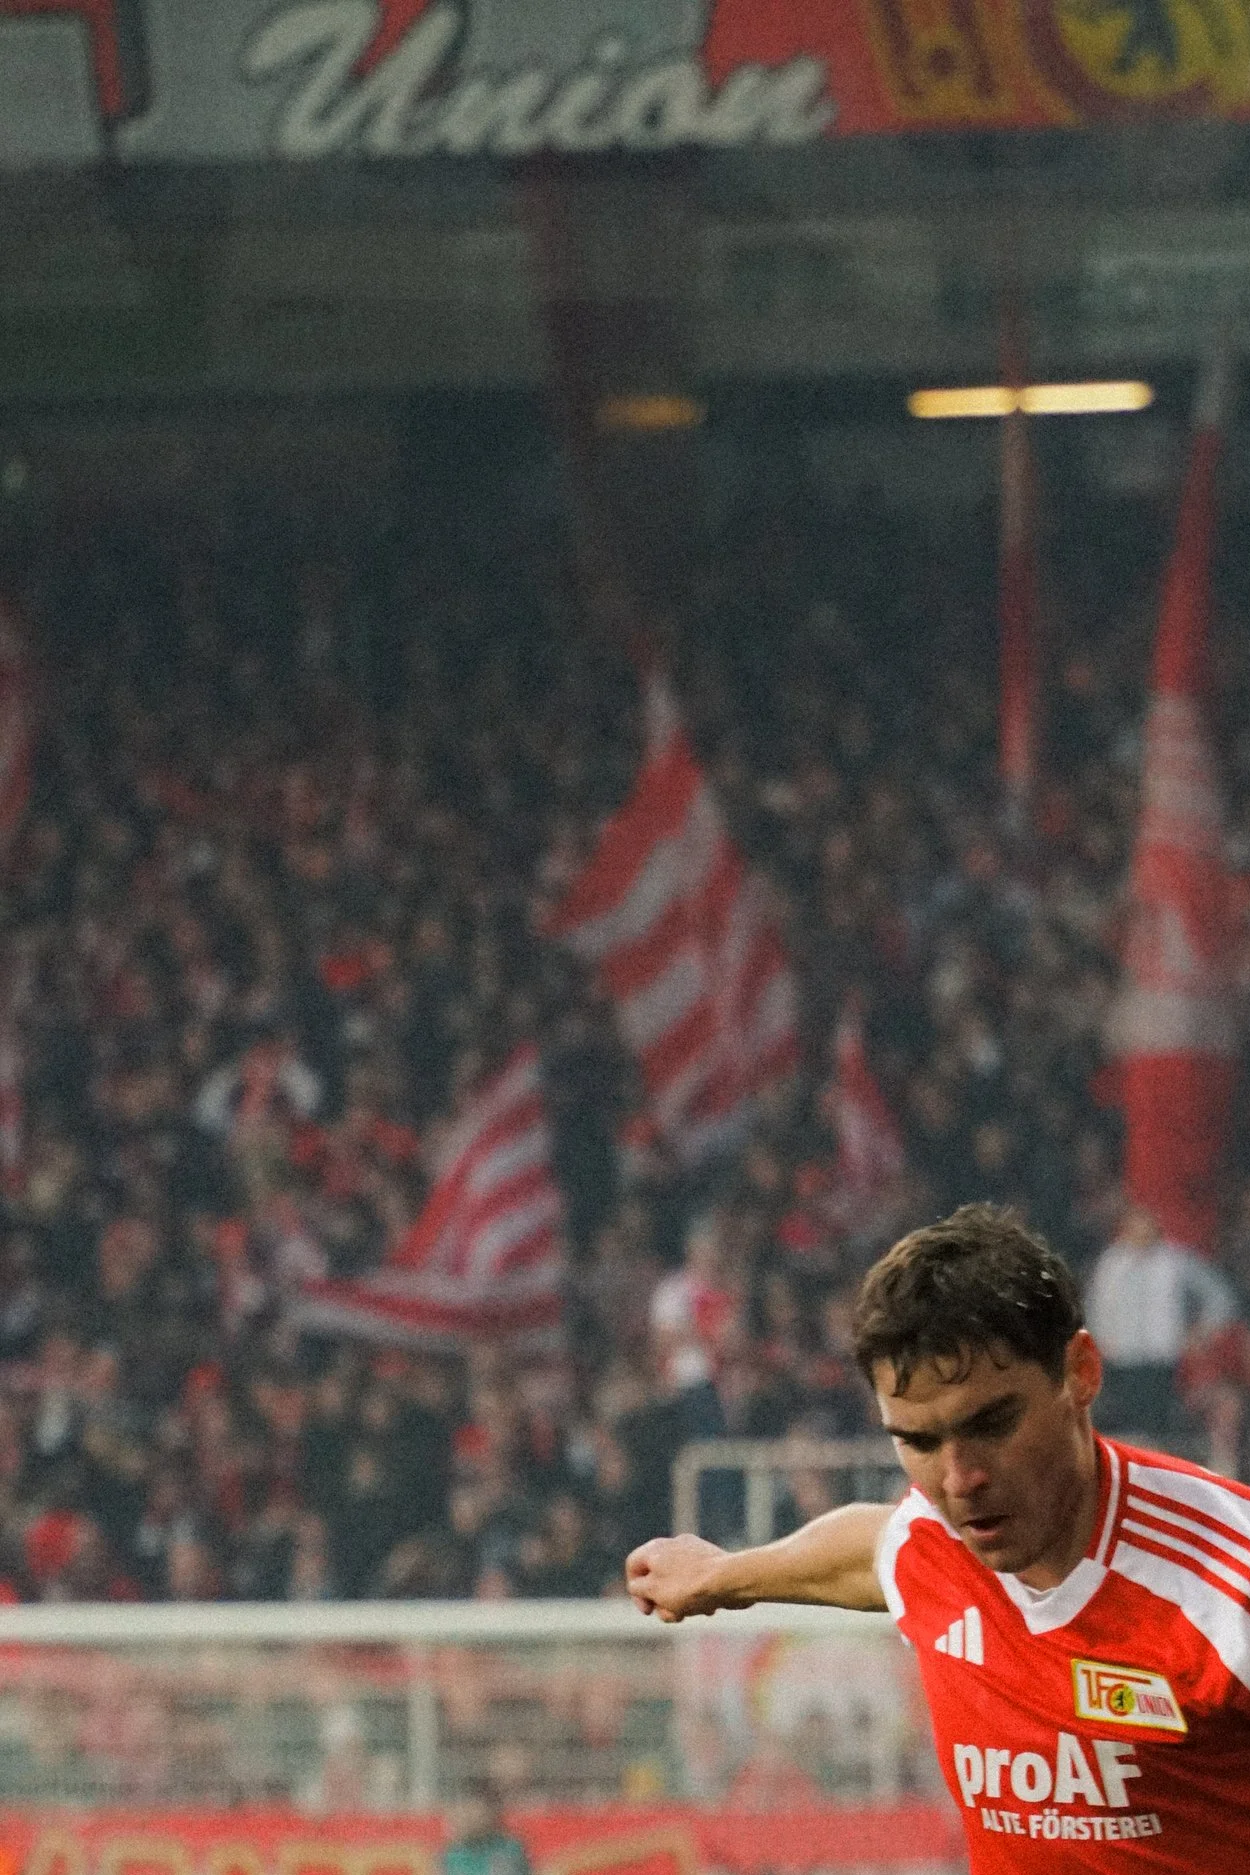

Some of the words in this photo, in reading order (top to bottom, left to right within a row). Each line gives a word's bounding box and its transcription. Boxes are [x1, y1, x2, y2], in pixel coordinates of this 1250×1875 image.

[240, 0, 840, 157] Union
[1136, 1693, 1176, 1719] UNION
[953, 1731, 1143, 1809] proAF
[981, 1807, 1027, 1835] ALTE
[1028, 1808, 1164, 1841] FÖRSTEREI
